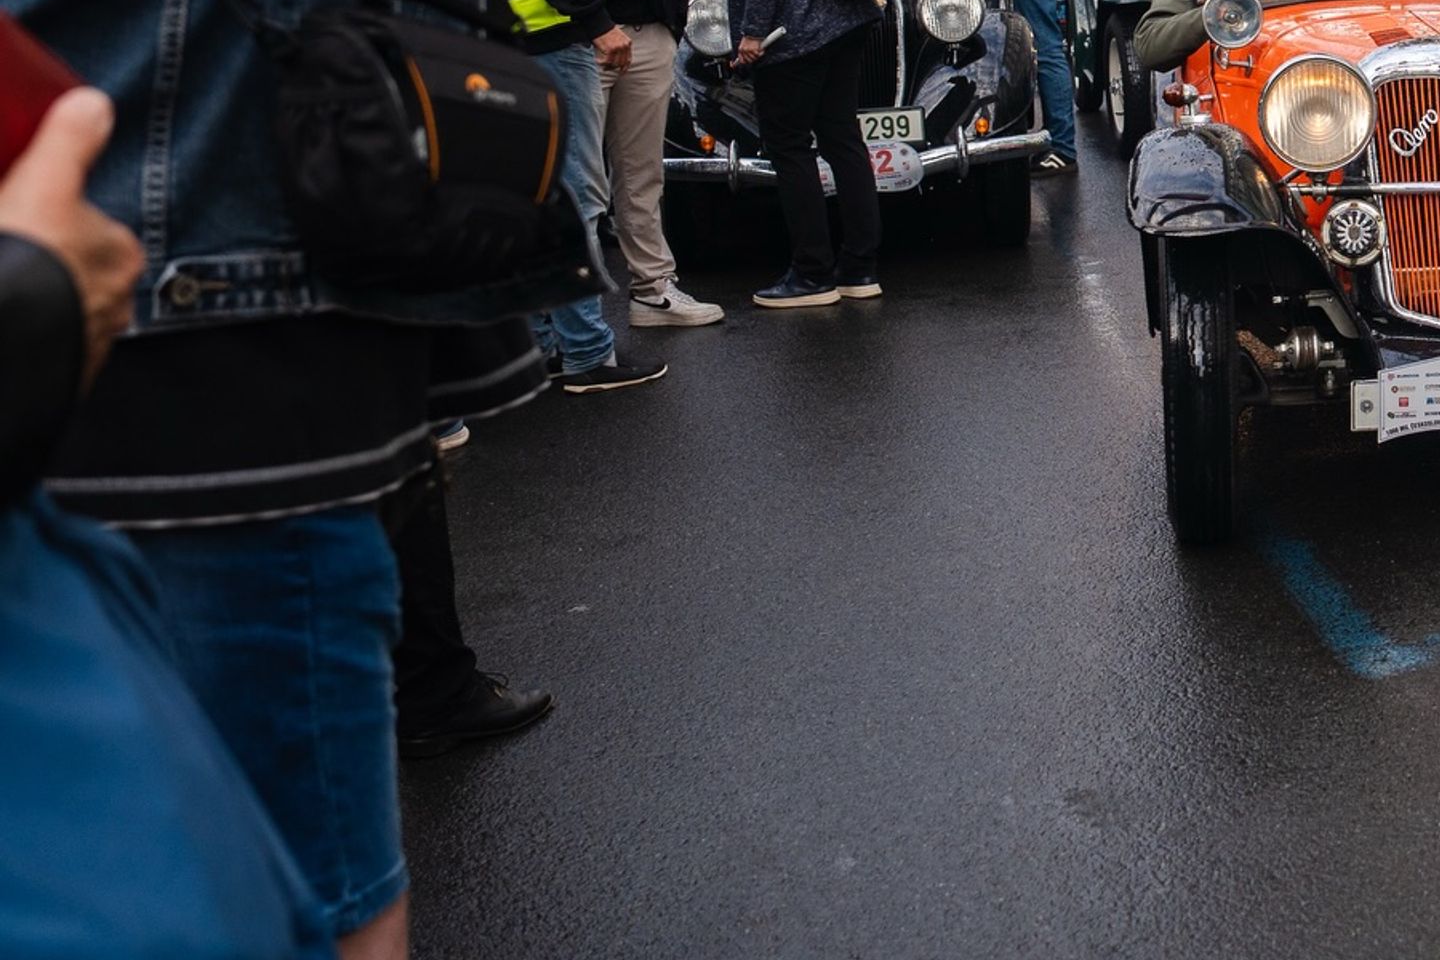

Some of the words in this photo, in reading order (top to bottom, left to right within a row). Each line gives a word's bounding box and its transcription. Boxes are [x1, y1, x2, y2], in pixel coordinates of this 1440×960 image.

[866, 115, 910, 140] 299
[1389, 109, 1438, 157] Aero
[871, 149, 895, 174] 2
